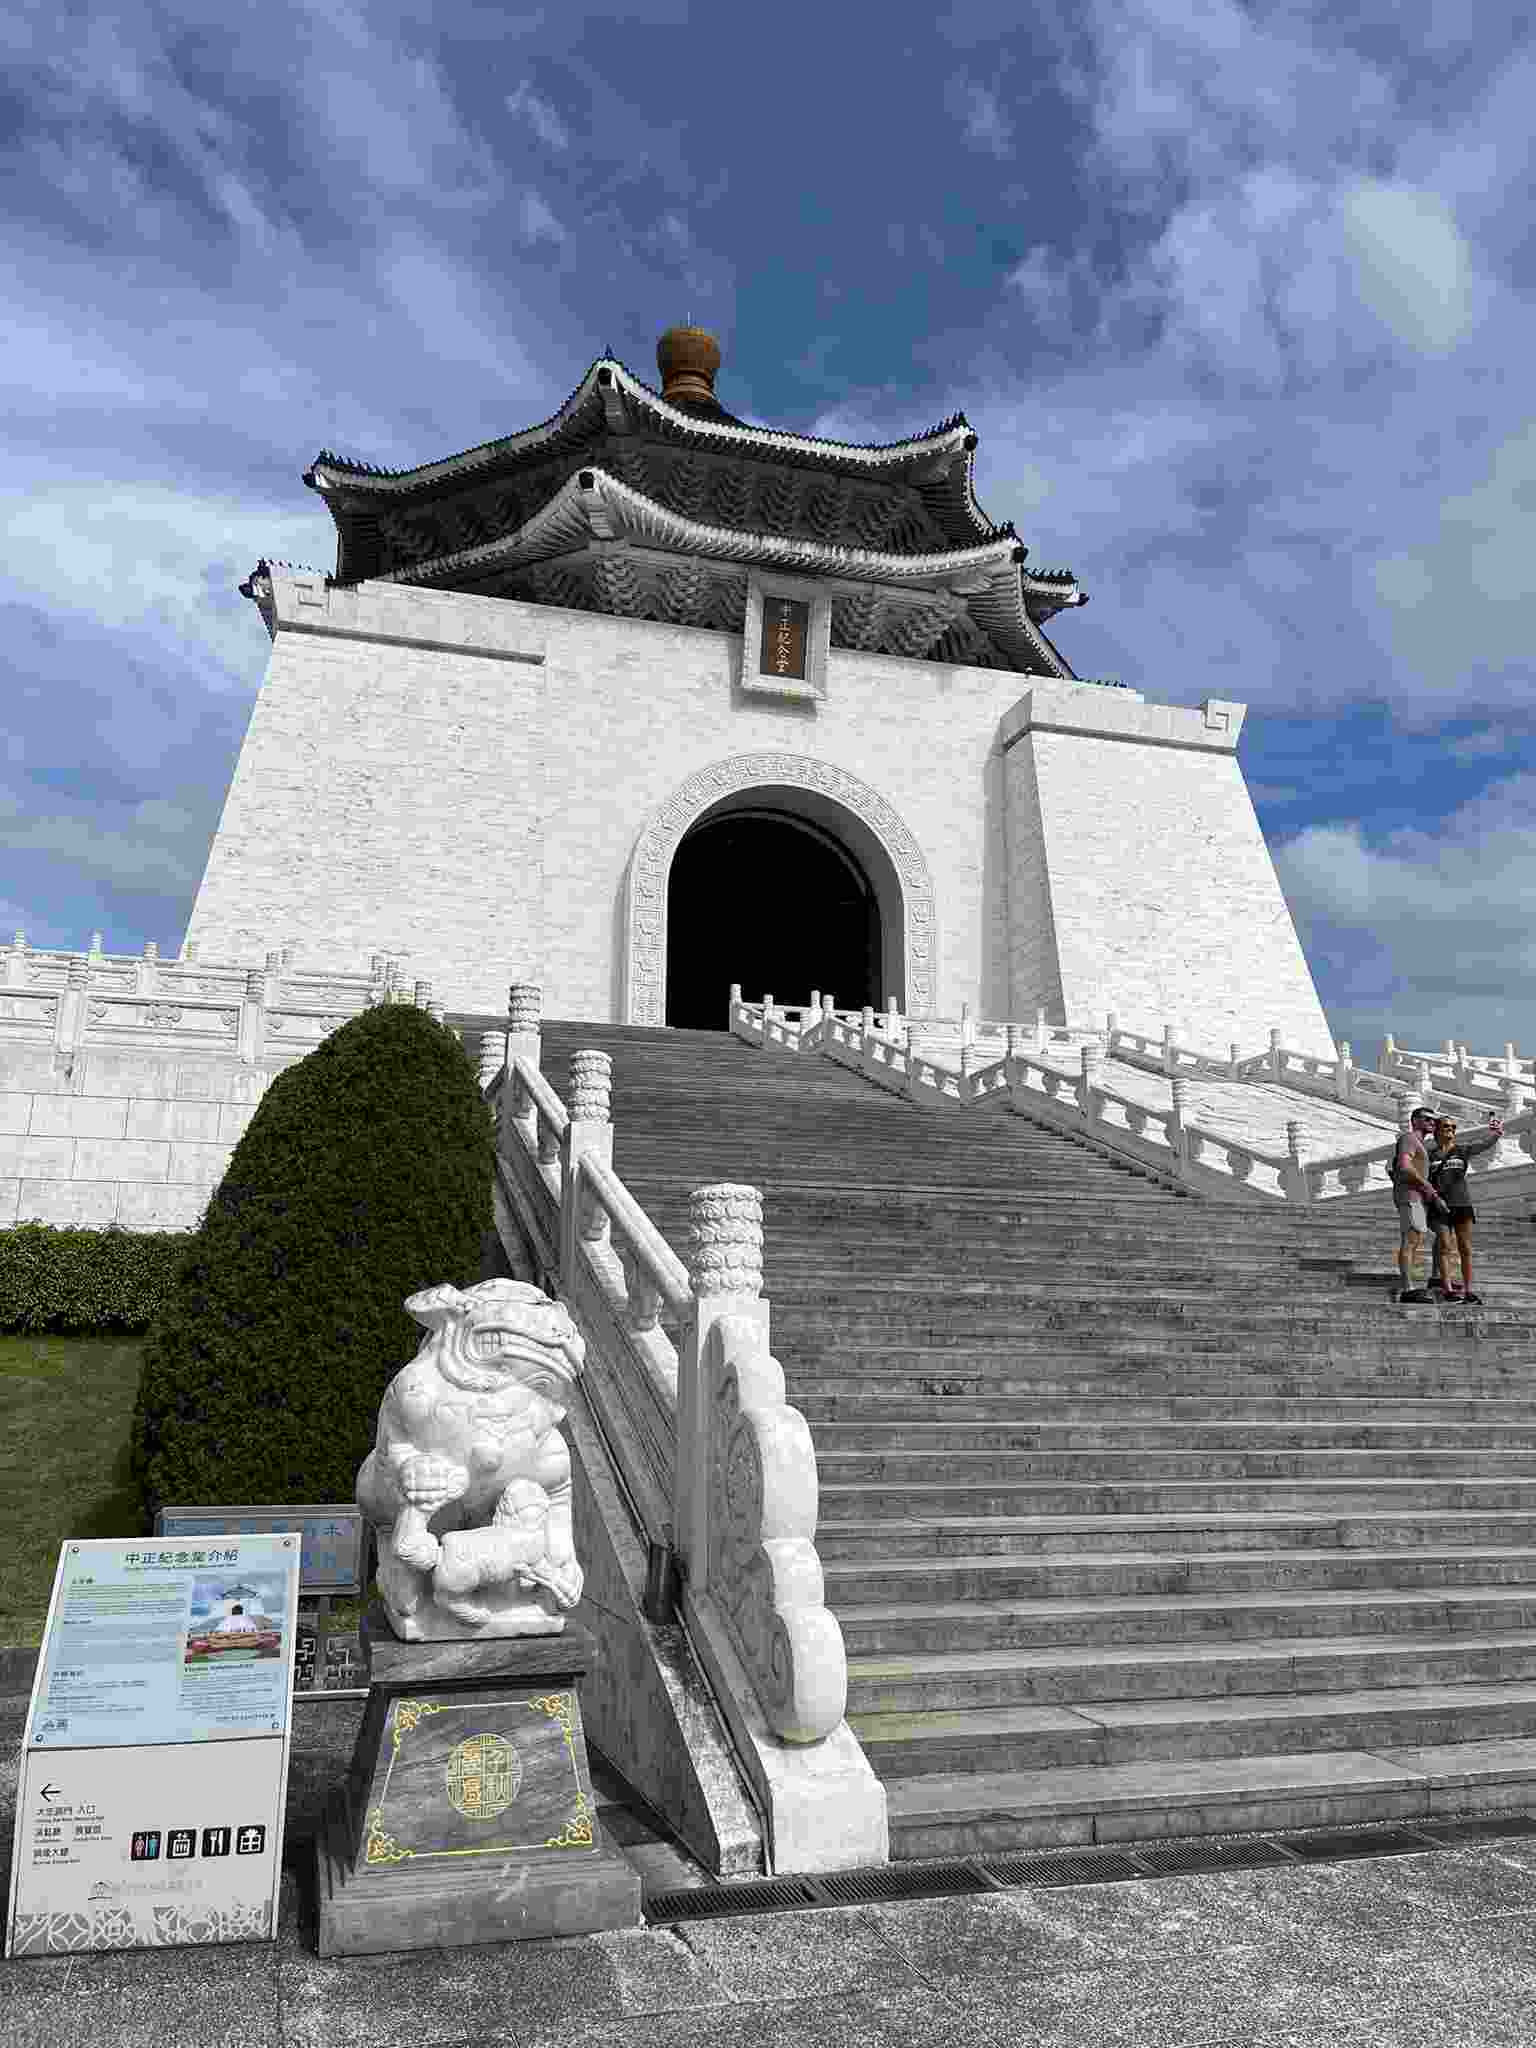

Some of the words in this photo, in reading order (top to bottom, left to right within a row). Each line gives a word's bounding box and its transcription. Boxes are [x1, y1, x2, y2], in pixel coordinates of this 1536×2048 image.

[125, 1549, 239, 1565] 中正紀念堂介紹
